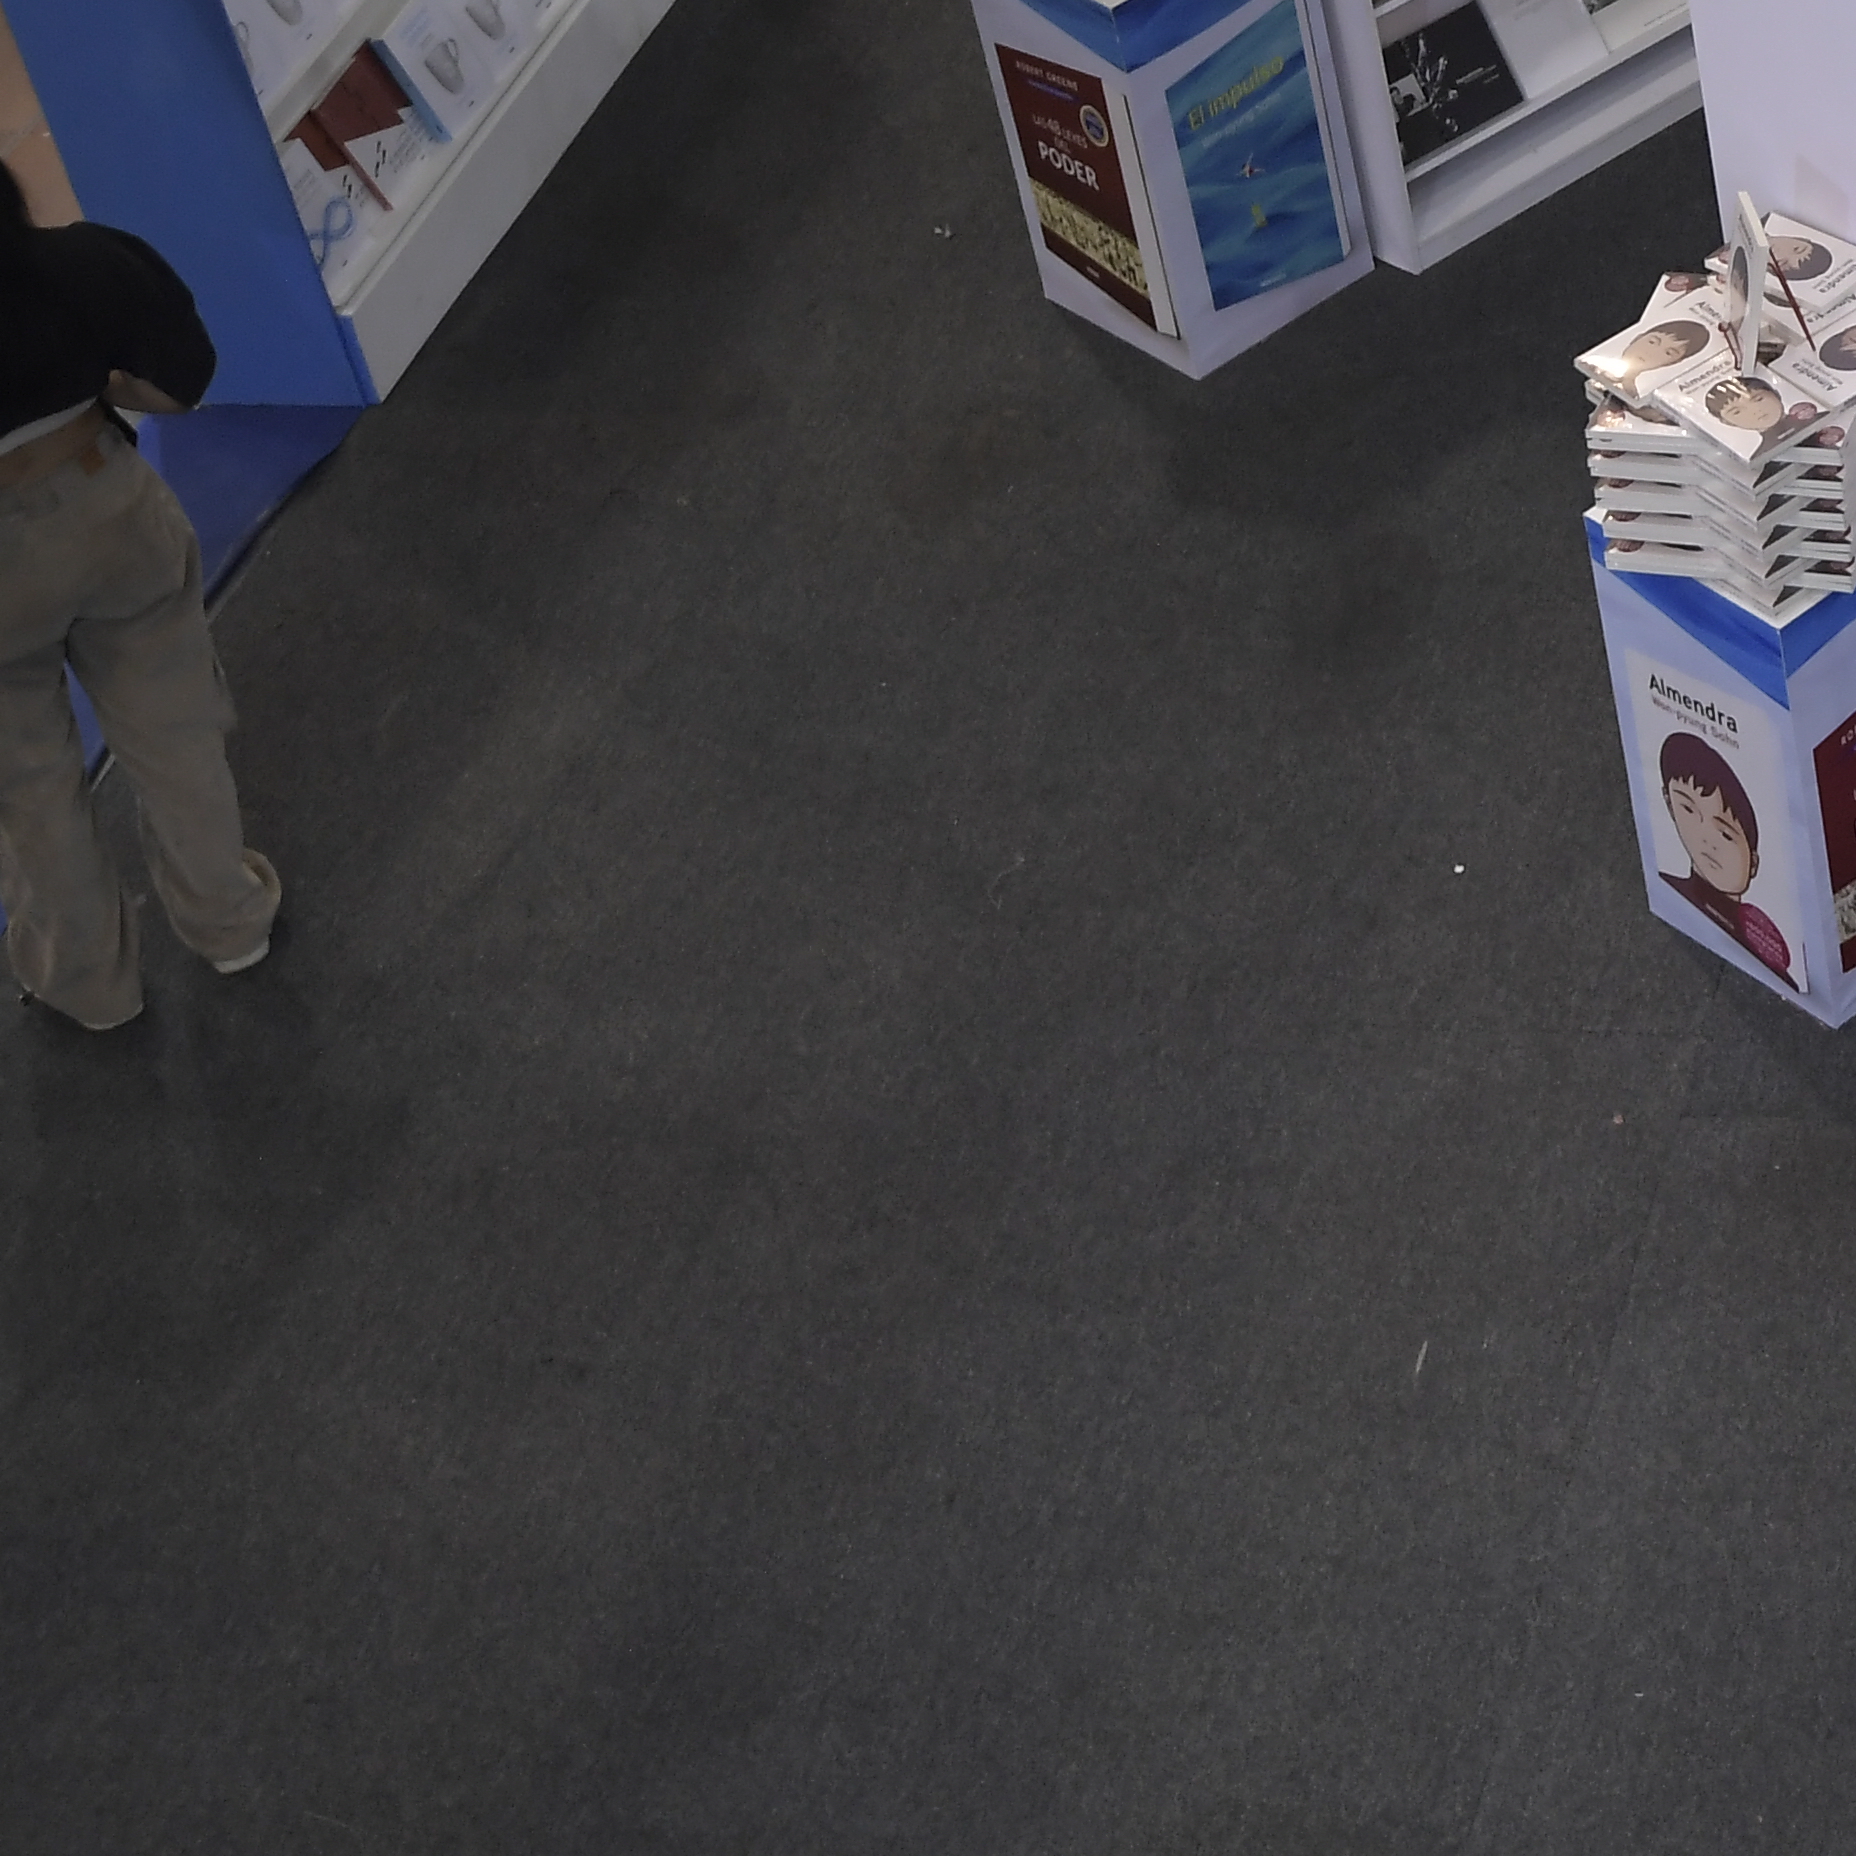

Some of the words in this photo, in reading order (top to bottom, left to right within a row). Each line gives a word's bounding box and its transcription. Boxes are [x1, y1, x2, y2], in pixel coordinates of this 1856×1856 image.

[1188, 104, 1205, 130] El
[1208, 56, 1284, 117] impulso
[1038, 141, 1100, 191] PODER
[1678, 359, 1732, 393] Almendra
[1792, 362, 1838, 393] Almendra
[1649, 673, 1738, 734] Almendra
[1710, 724, 1740, 749] Sohn
